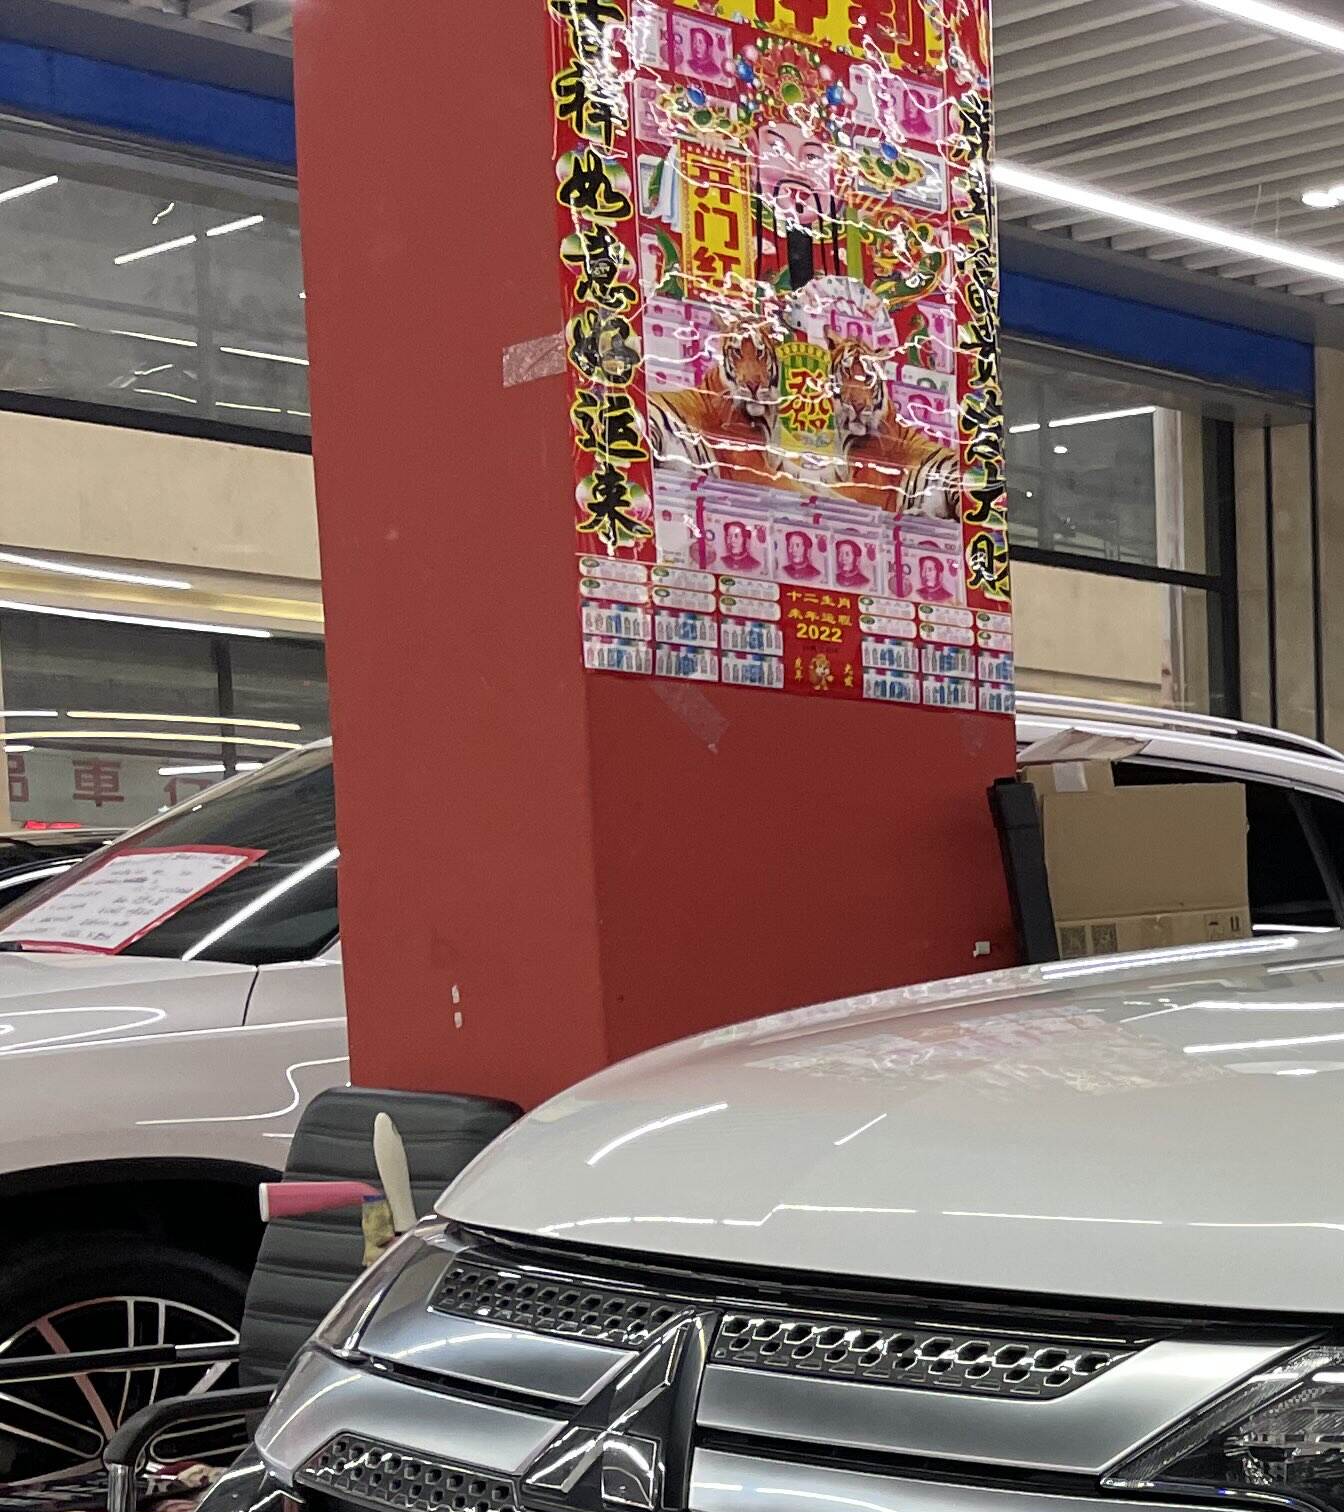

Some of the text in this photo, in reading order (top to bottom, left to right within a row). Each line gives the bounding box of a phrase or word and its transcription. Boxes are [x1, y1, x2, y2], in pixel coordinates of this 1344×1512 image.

[690, 159, 742, 291] 开门红
[796, 623, 843, 643] 2022
